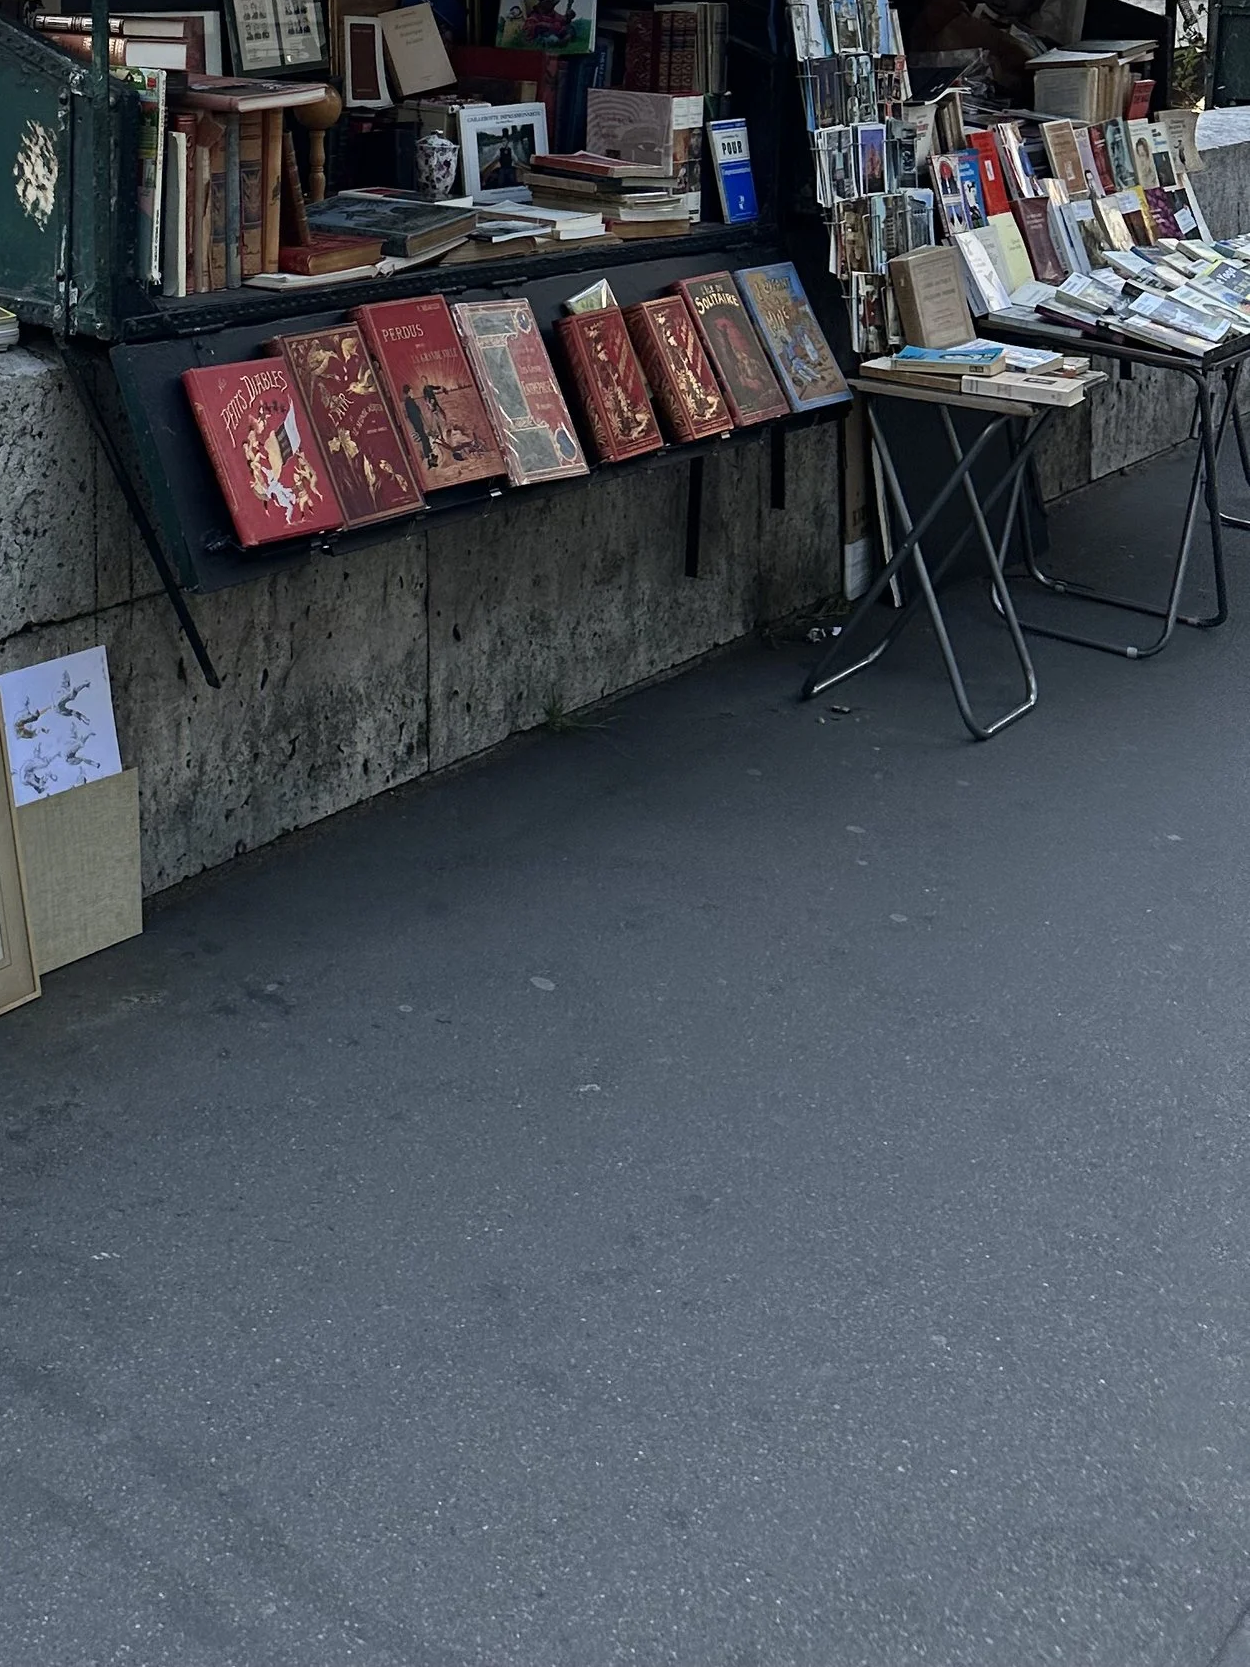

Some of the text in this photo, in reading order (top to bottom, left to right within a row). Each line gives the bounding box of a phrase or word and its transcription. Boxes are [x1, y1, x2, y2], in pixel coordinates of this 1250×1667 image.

[721, 140, 743, 155] POUR
[1216, 267, 1236, 281] Yoga
[694, 292, 739, 315] SOLITAIRE
[382, 323, 424, 342] PERDUS
[240, 370, 288, 407] DIABLES
